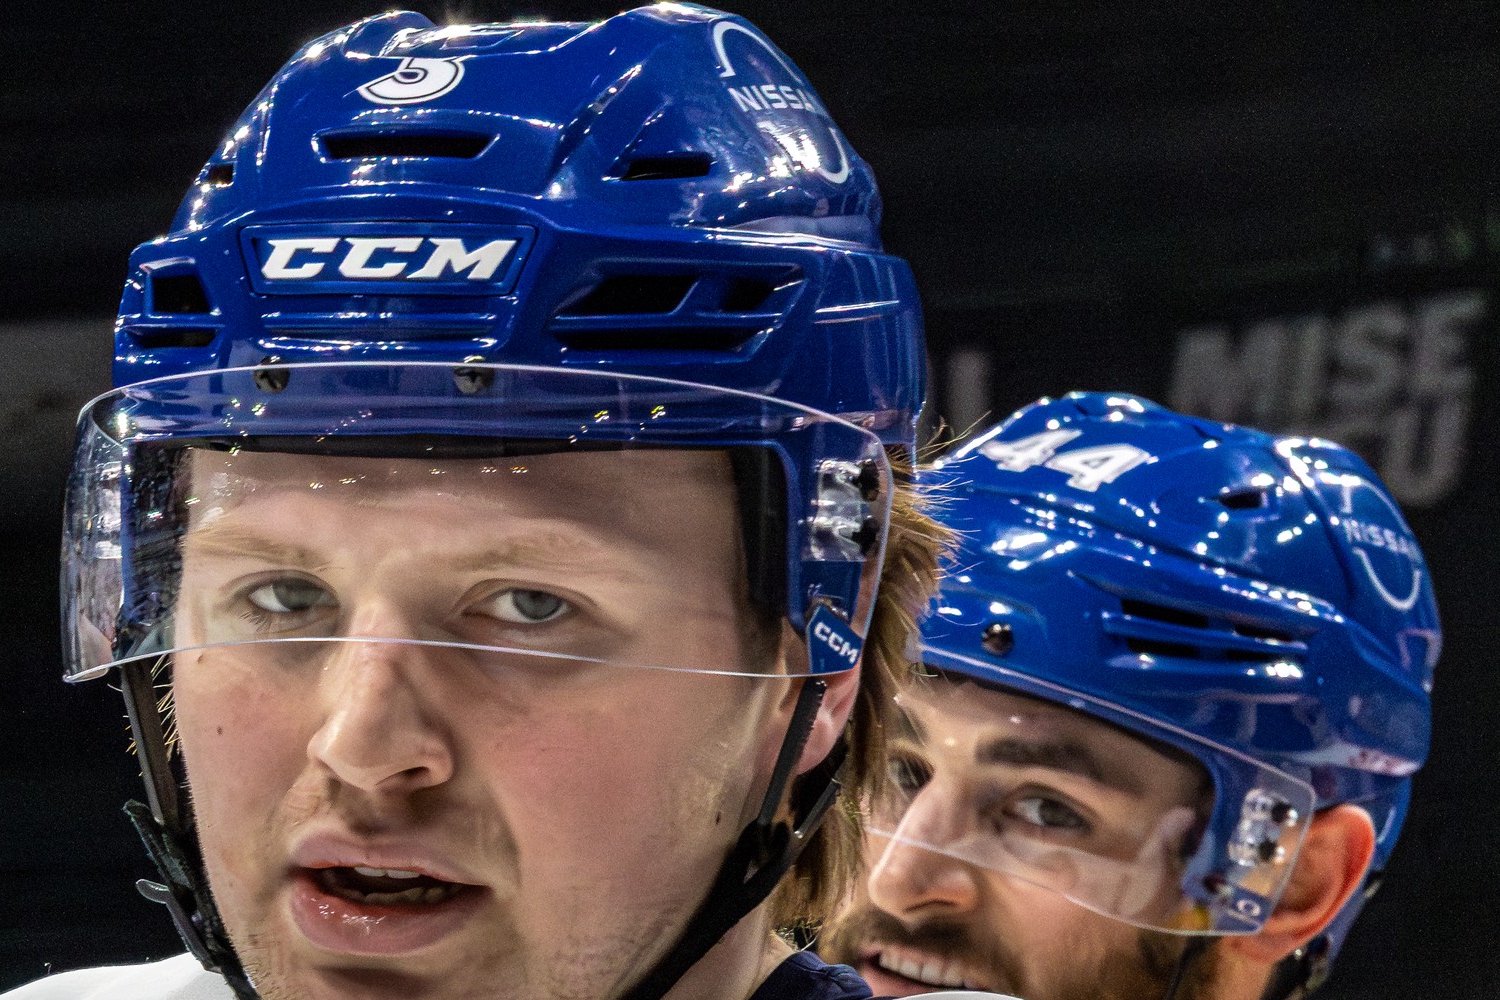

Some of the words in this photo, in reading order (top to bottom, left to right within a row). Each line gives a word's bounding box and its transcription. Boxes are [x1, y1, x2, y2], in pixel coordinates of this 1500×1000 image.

[261, 236, 517, 281] CCM
[978, 428, 1150, 492] 44
[1341, 516, 1423, 563] NISS
[814, 621, 859, 664] CCM
